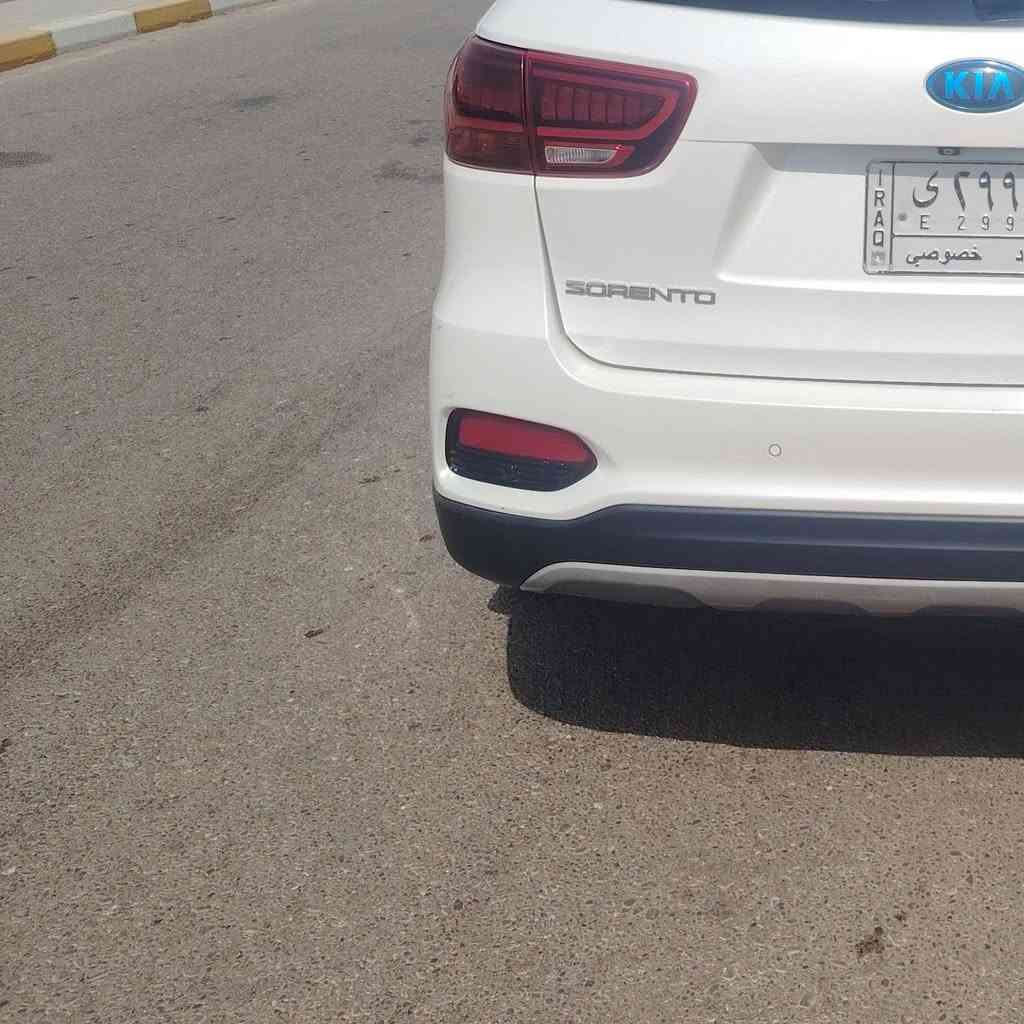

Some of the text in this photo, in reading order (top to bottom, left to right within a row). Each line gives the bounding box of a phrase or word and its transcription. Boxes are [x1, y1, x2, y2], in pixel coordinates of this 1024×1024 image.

[943, 70, 1014, 98] KIA
[872, 168, 886, 248] IRAQ
[919, 214, 931, 230] E
[905, 246, 983, 267] خصوصي
[564, 279, 717, 305] SORENTO
